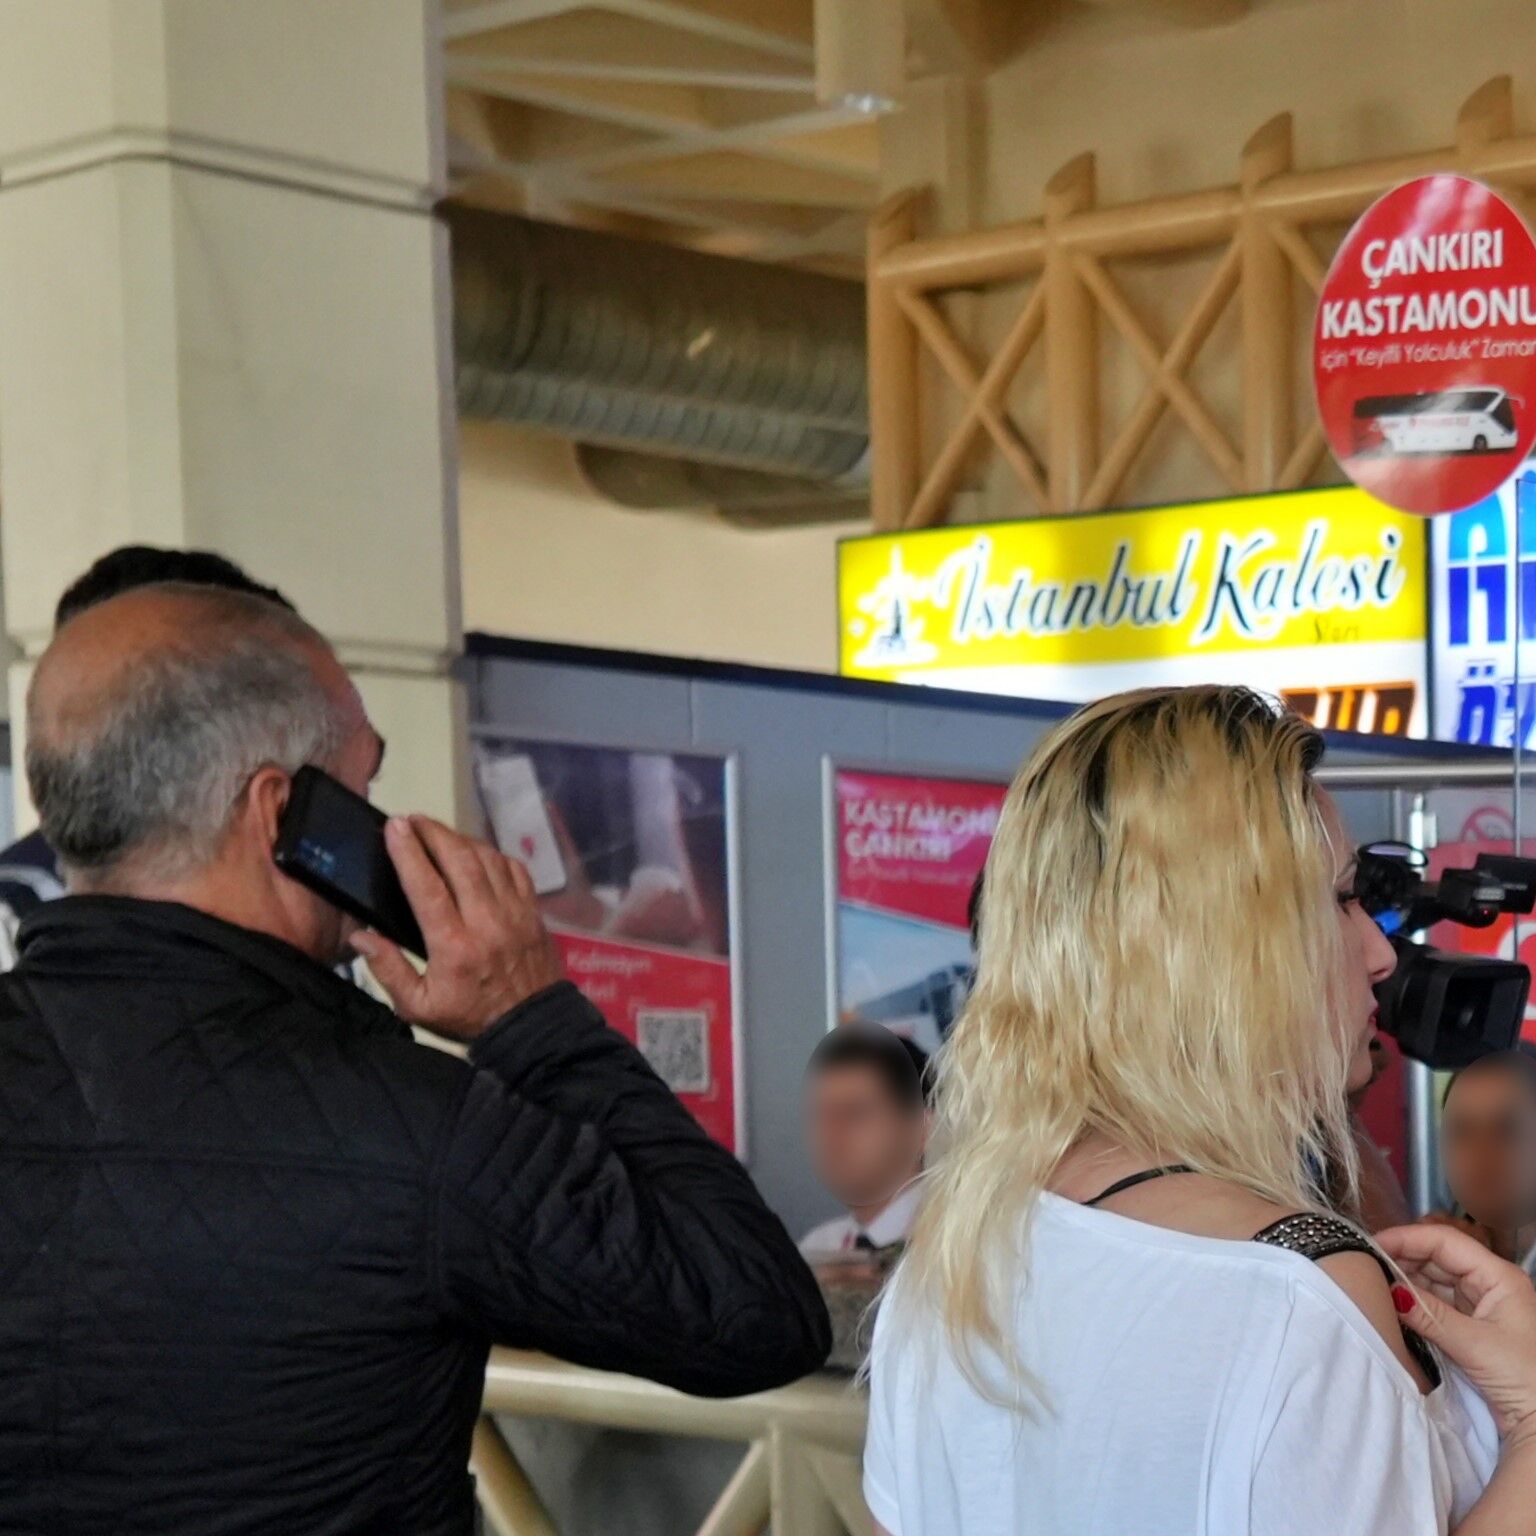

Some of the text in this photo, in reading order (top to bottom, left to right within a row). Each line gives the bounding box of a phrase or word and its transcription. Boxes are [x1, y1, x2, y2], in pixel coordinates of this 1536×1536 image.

[1361, 229, 1504, 289] ÇANKIRI
[936, 522, 1405, 644] İstanbul Kalesi
